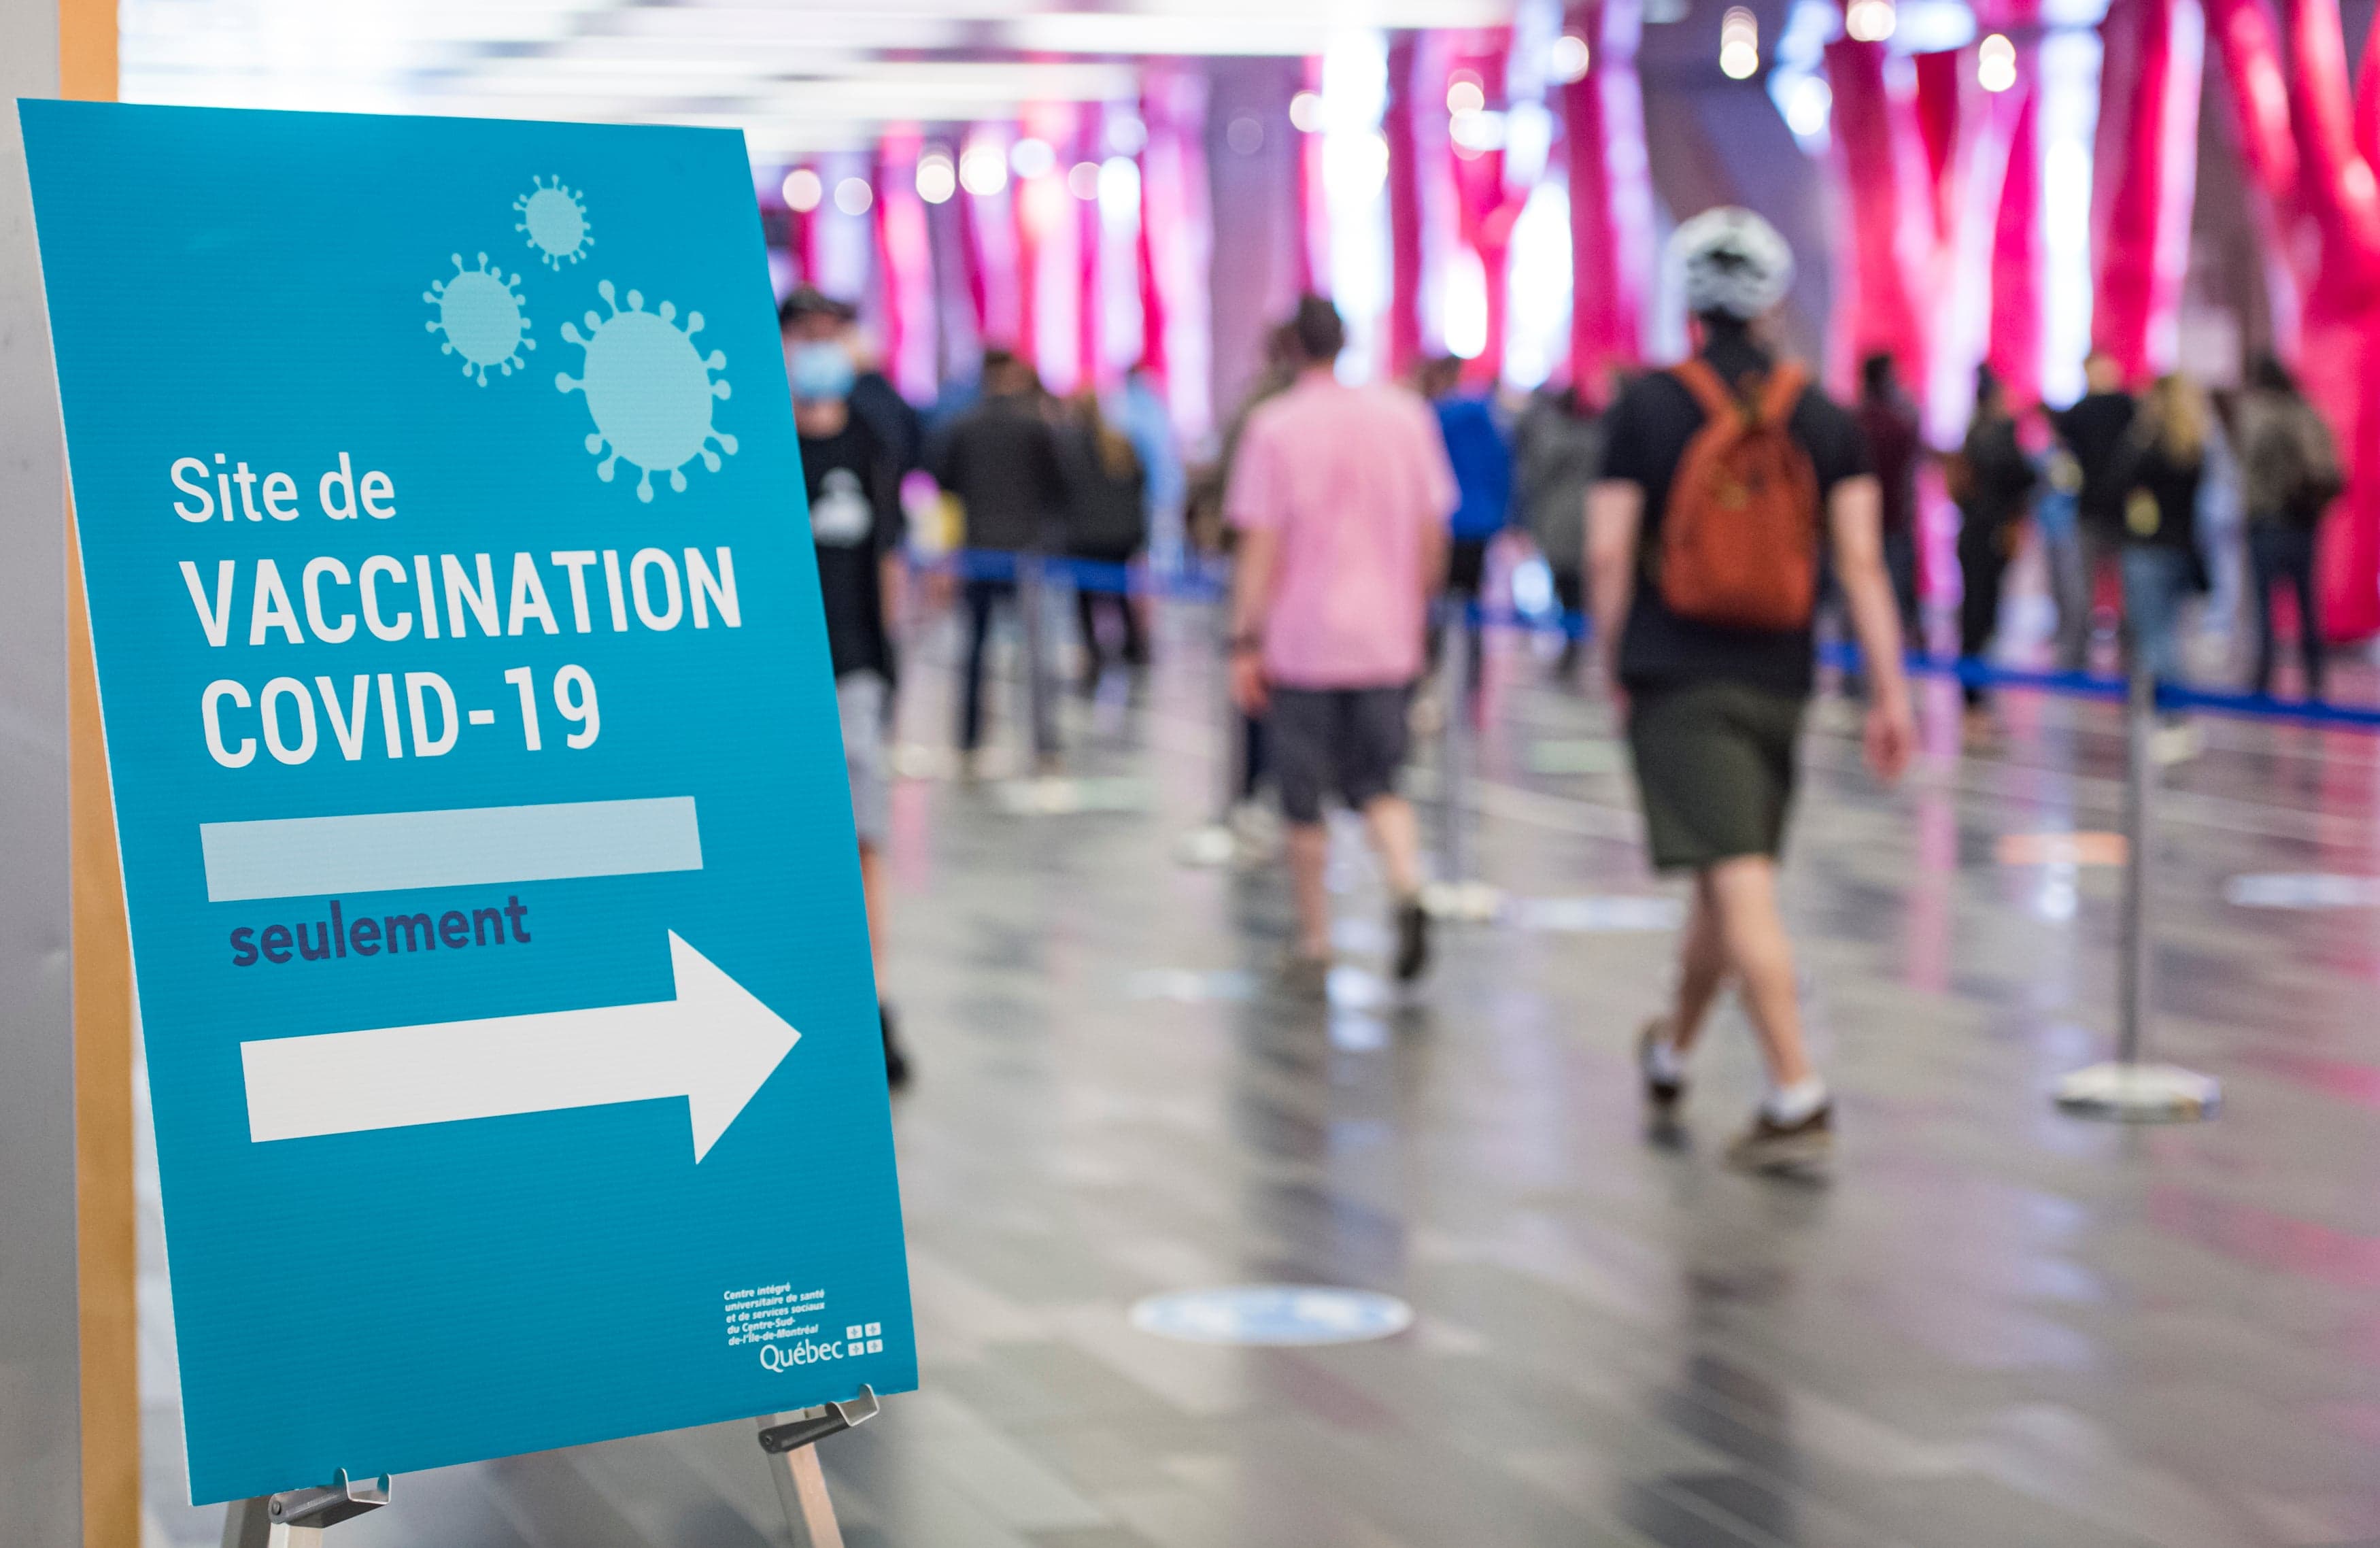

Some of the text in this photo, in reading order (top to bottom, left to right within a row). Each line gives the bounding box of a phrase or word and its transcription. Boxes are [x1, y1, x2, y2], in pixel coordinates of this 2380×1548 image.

[169, 452, 396, 523] Site de
[178, 546, 742, 647] VACCINATION
[201, 664, 600, 768] COVID-19
[229, 895, 532, 966] seulement
[724, 1282, 791, 1300] Centre intégré
[725, 1289, 825, 1311] universitaire de santé
[726, 1302, 825, 1323] et de services sociaux
[727, 1316, 796, 1334] du Centre-Sud-
[760, 1339, 844, 1373] Québec
